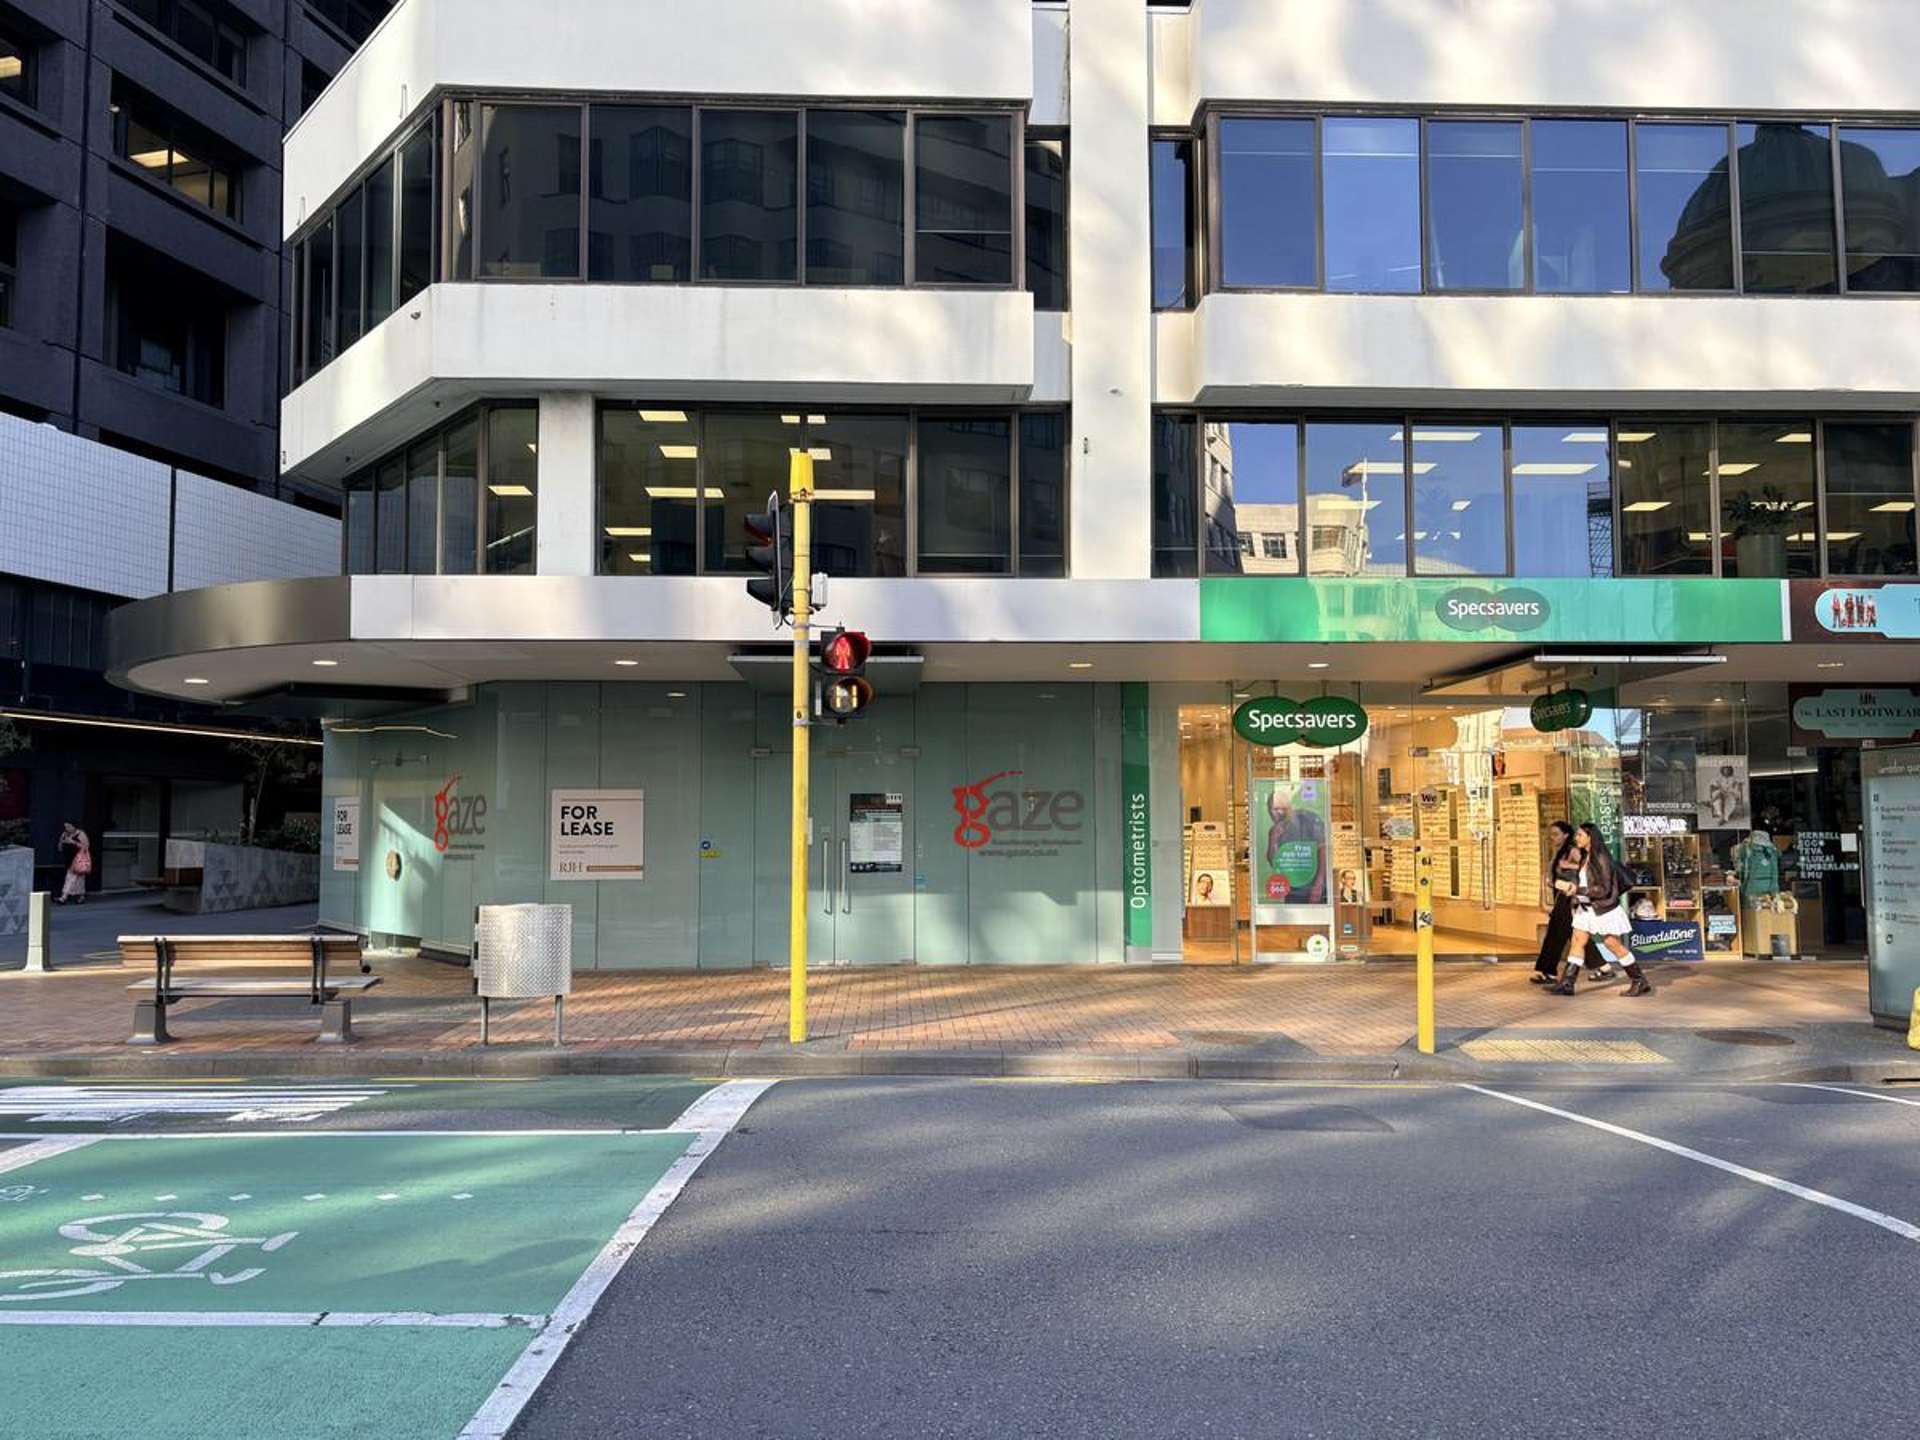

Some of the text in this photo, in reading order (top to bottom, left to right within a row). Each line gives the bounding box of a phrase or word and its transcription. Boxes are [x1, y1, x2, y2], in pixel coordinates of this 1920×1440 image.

[1447, 599, 1540, 620] Specsavers
[1248, 709, 1357, 732] Specsavers
[1816, 707, 1845, 718] LAST
[337, 809, 349, 822] FOR
[434, 774, 488, 853] gaze
[561, 805, 598, 820] FOR
[952, 770, 1085, 848] gaze
[336, 823, 353, 835] LEASE
[561, 822, 614, 836] LEASE
[1130, 793, 1149, 909] Optometrists
[1631, 928, 1697, 946] Blundstone
